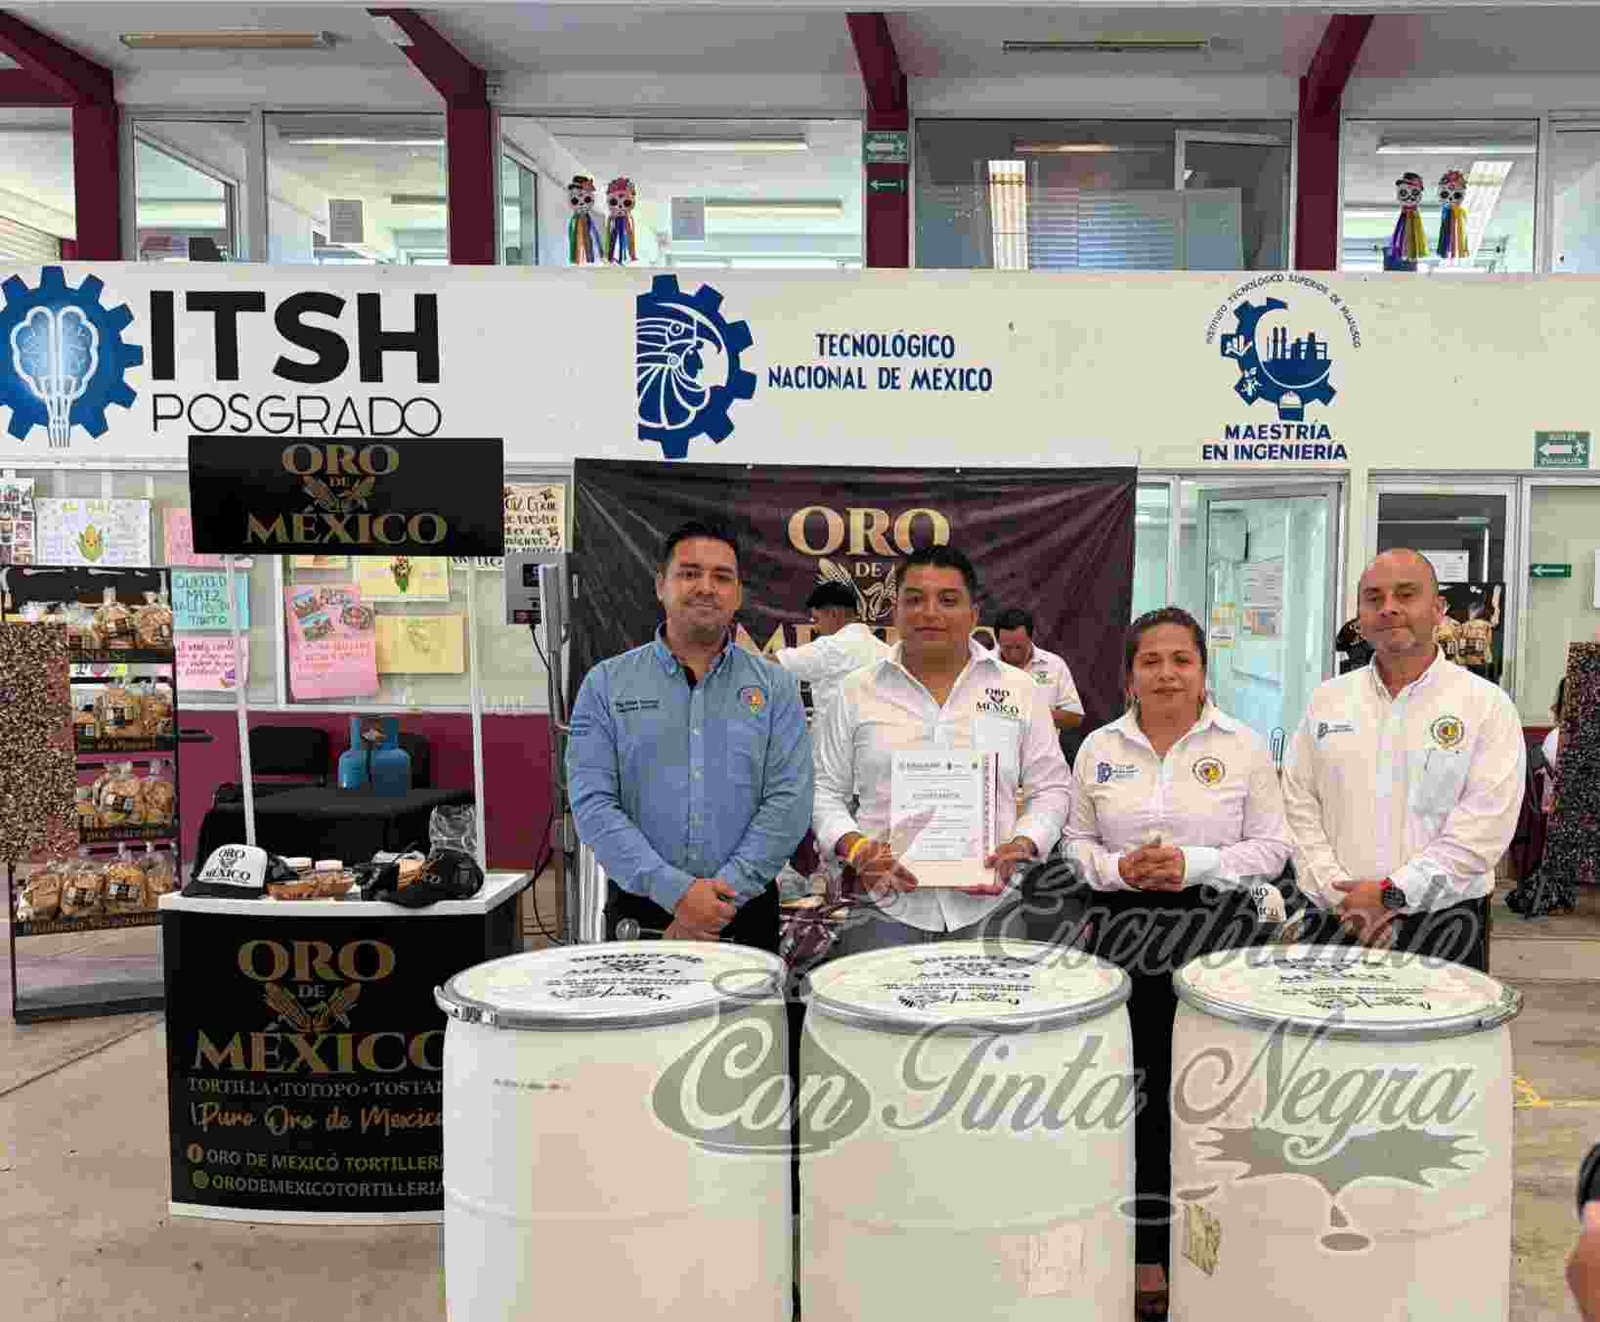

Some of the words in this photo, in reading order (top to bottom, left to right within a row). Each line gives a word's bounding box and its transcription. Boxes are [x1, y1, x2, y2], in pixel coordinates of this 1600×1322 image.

[150, 291, 440, 384] ITSH
[768, 366, 866, 390] NACIONAL
[877, 366, 901, 389] DE
[152, 394, 442, 437] POSGRADO
[281, 444, 399, 475] ORO
[1202, 444, 1228, 460] EN
[788, 506, 951, 557] ORO
[855, 562, 882, 577] DE
[218, 848, 245, 858] ORO
[237, 939, 396, 983] ORO
[298, 985, 326, 998] DE
[264, 1105, 314, 1136] Oro
[325, 1105, 351, 1131] de
[206, 1149, 241, 1165] ORO
[245, 1152, 267, 1168] DE
